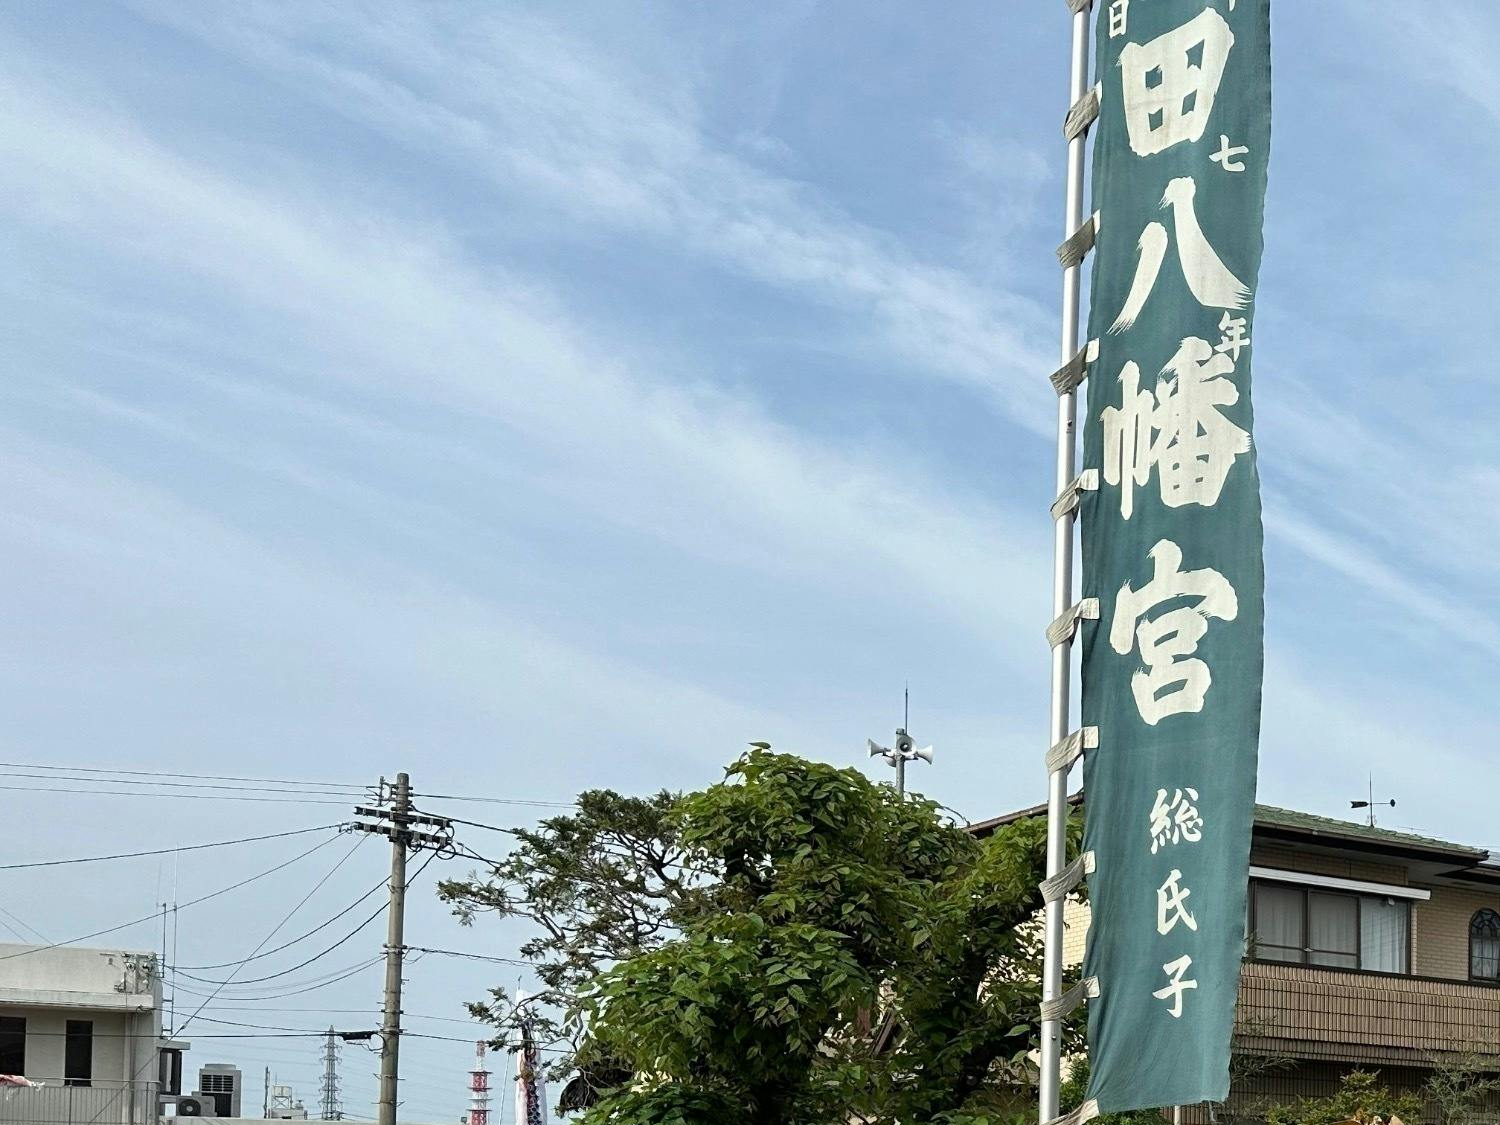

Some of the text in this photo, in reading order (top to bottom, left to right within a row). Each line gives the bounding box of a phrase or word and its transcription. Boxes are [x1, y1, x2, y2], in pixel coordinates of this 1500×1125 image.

[1101, 7, 1254, 725] 田八幡宮
[1150, 787, 1203, 1018] 総氏子
